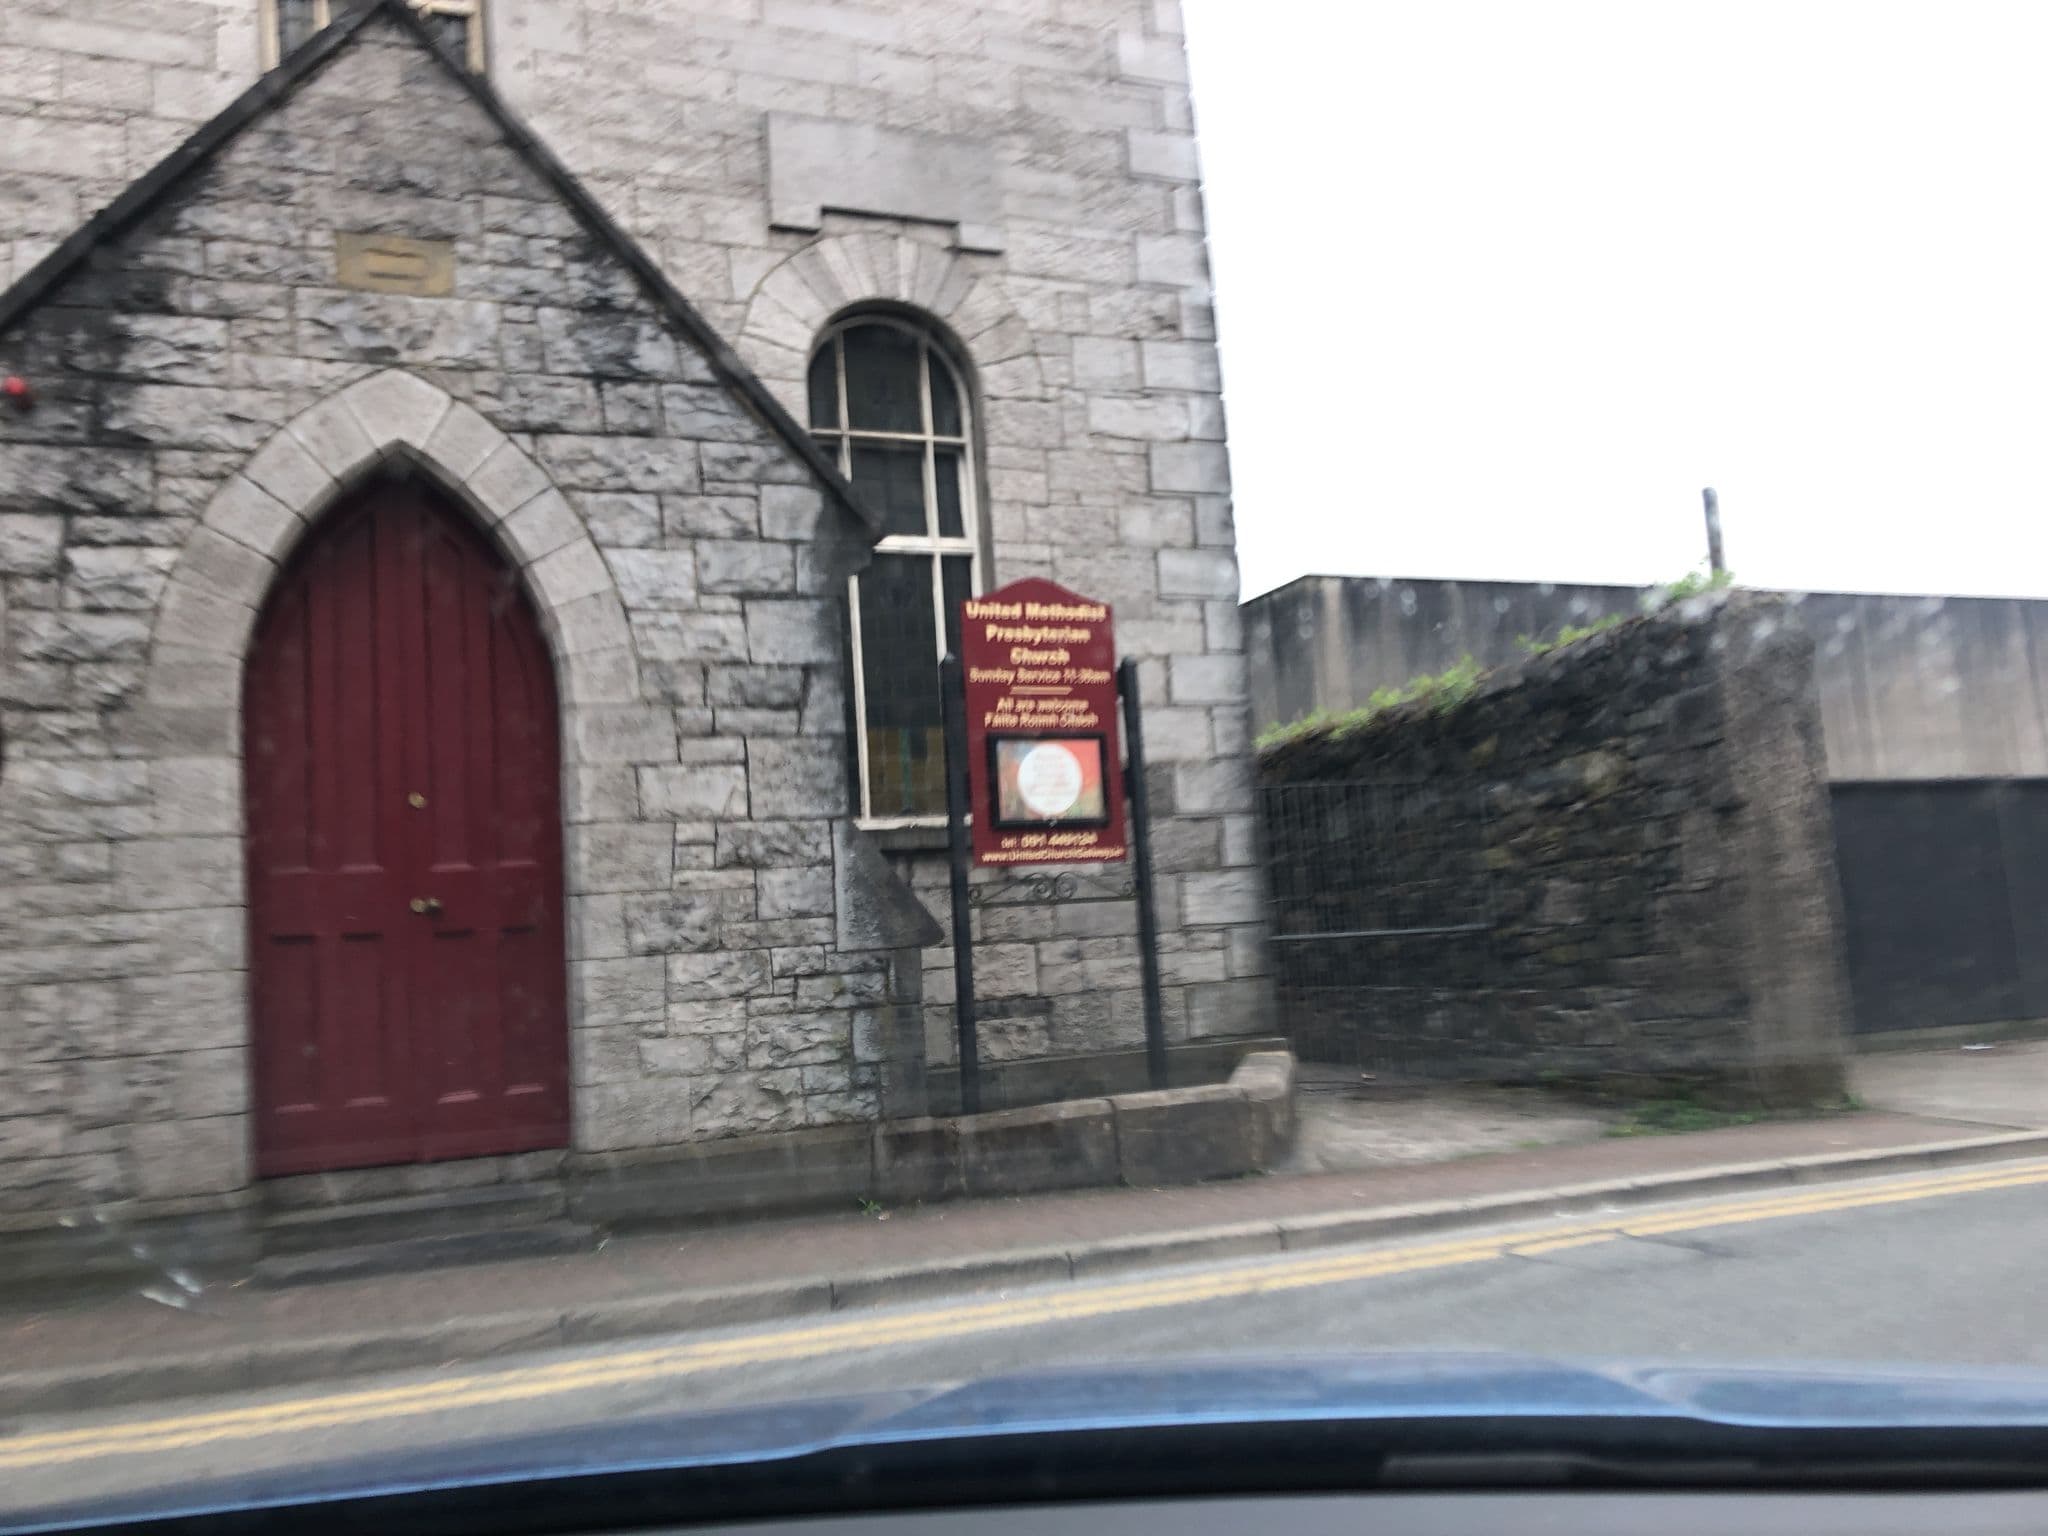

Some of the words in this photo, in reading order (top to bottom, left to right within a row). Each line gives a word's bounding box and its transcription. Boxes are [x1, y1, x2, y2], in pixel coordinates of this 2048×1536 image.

[966, 601, 1022, 620] United
[1025, 601, 1106, 622] Methodist
[986, 624, 1091, 645] Presbyterian
[1010, 647, 1070, 665] Church
[969, 667, 1016, 685] Sunday
[1017, 667, 1062, 684] Service
[996, 697, 1014, 712] All
[1015, 699, 1035, 712] are
[1036, 698, 1089, 713] welcome
